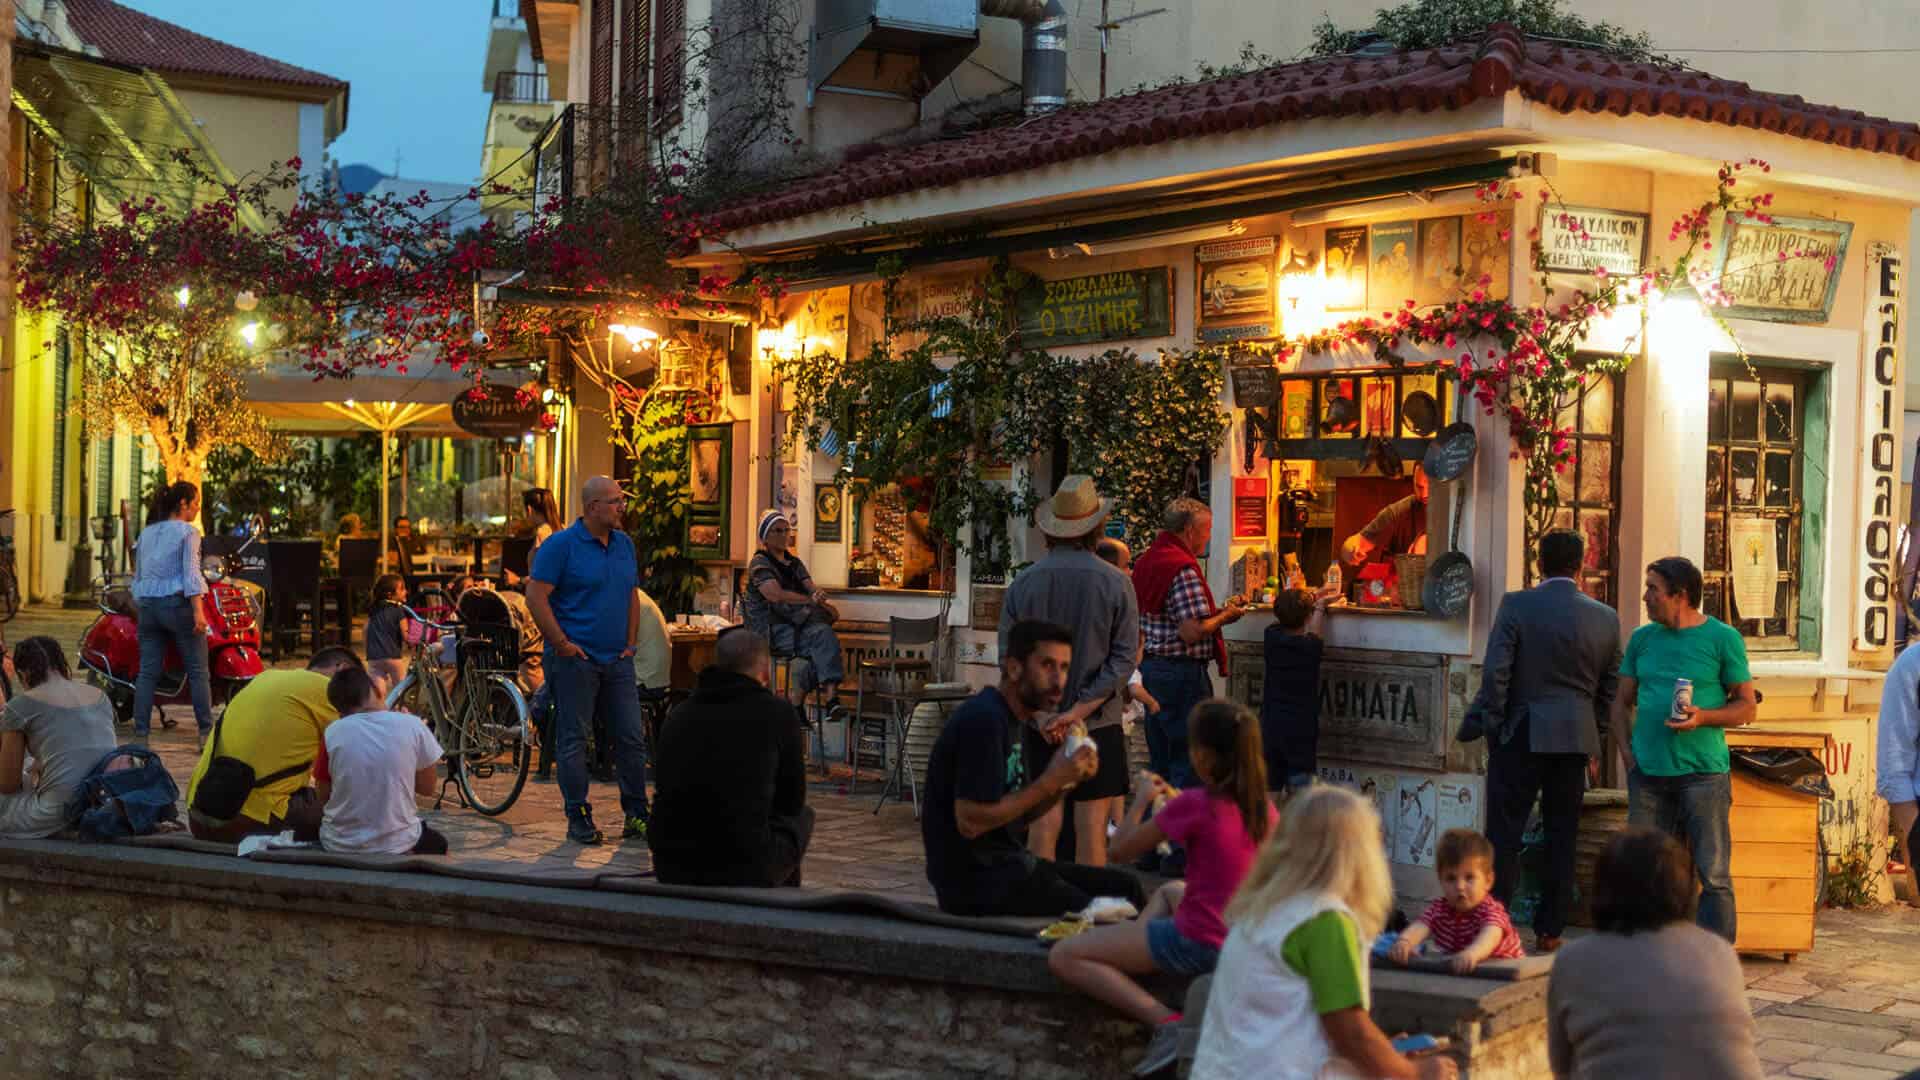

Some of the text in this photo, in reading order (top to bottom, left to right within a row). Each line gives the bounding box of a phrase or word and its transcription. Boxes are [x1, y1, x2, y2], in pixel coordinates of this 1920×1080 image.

[1044, 272, 1136, 304] ΣΟΥΒΛΑΚΙΑ
[1040, 299, 1142, 336] Ο ΤΖΙΜΗΣ
